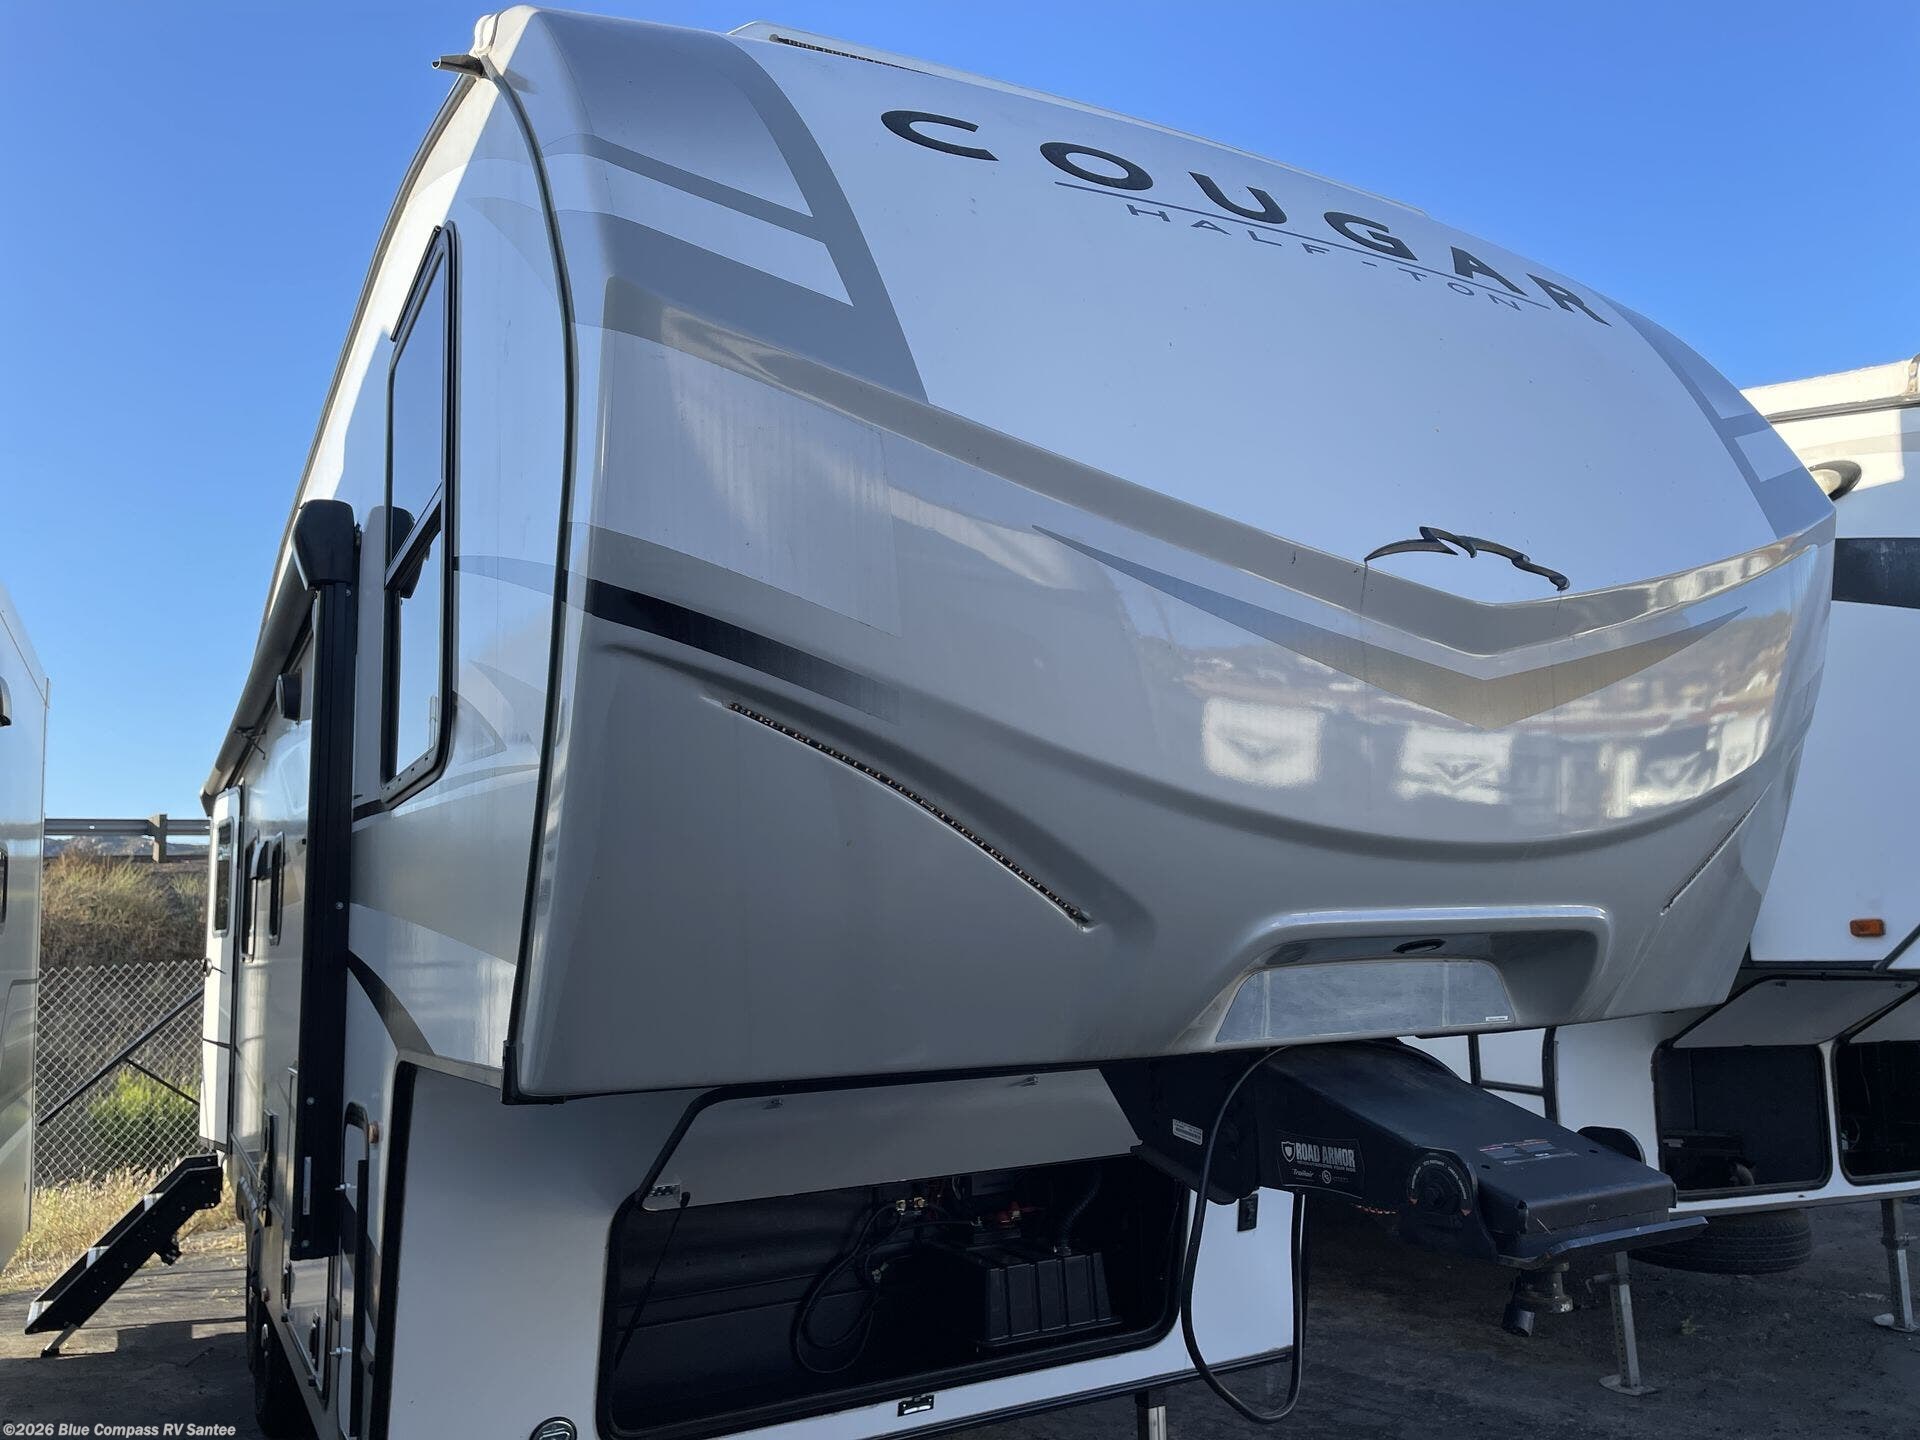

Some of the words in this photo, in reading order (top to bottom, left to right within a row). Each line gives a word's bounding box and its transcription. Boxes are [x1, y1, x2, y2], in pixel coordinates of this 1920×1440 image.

[881, 110, 1611, 326] COUGAR
[1127, 203, 1522, 311] HALF-TON
[1296, 1142, 1320, 1162] ROAD
[1321, 1145, 1355, 1168] ARMOR
